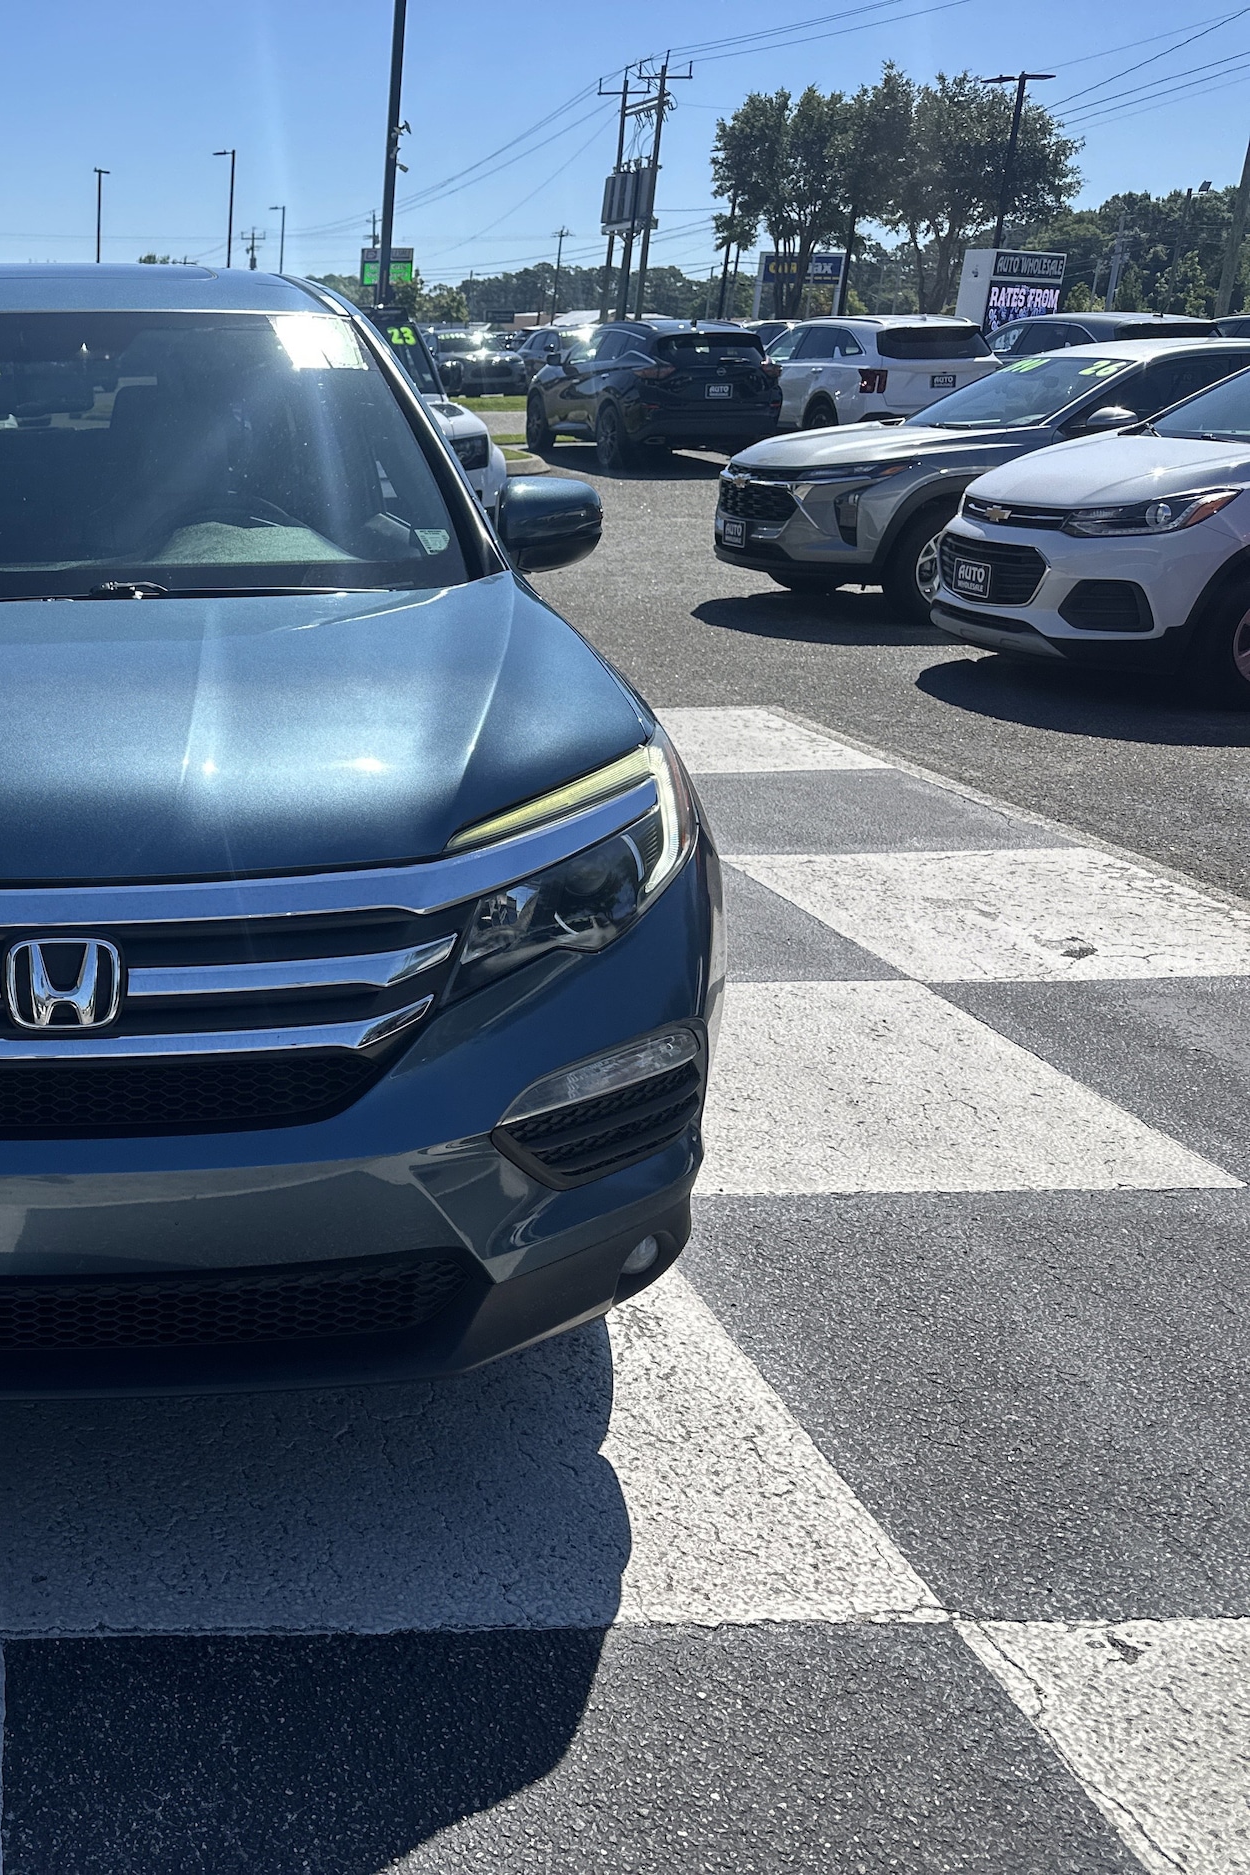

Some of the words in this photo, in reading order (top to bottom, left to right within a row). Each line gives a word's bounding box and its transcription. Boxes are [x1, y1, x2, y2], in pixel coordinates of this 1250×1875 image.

[996, 256, 1020, 274] AUTO
[1021, 256, 1064, 276] WHOLESALE
[989, 287, 1026, 307] RATES
[1027, 288, 1060, 310] FROM
[387, 327, 417, 345] 23
[1078, 360, 1126, 377] 26
[934, 376, 954, 384] AUTO
[709, 385, 729, 393] AUTO
[958, 564, 985, 583] AUTO
[958, 580, 984, 592] WHOLESALE
